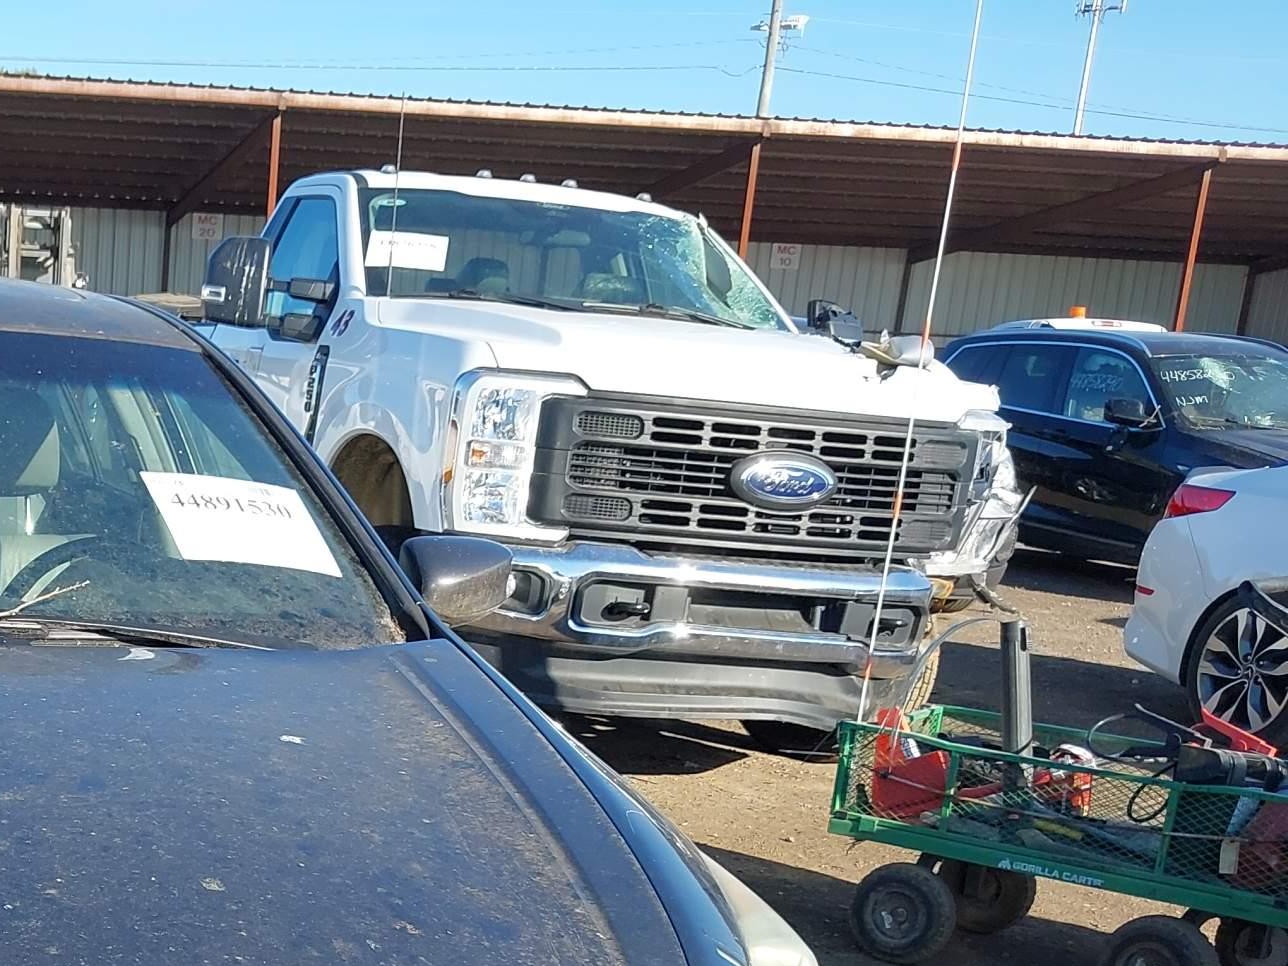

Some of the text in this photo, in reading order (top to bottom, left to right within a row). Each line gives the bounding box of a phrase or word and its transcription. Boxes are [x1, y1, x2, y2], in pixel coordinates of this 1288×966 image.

[198, 215, 217, 225] MC
[776, 245, 796, 256] MC
[779, 257, 792, 267] 10
[756, 467, 816, 492] Ford
[170, 492, 292, 519] 44891530
[1012, 861, 1060, 879] GORILLA
